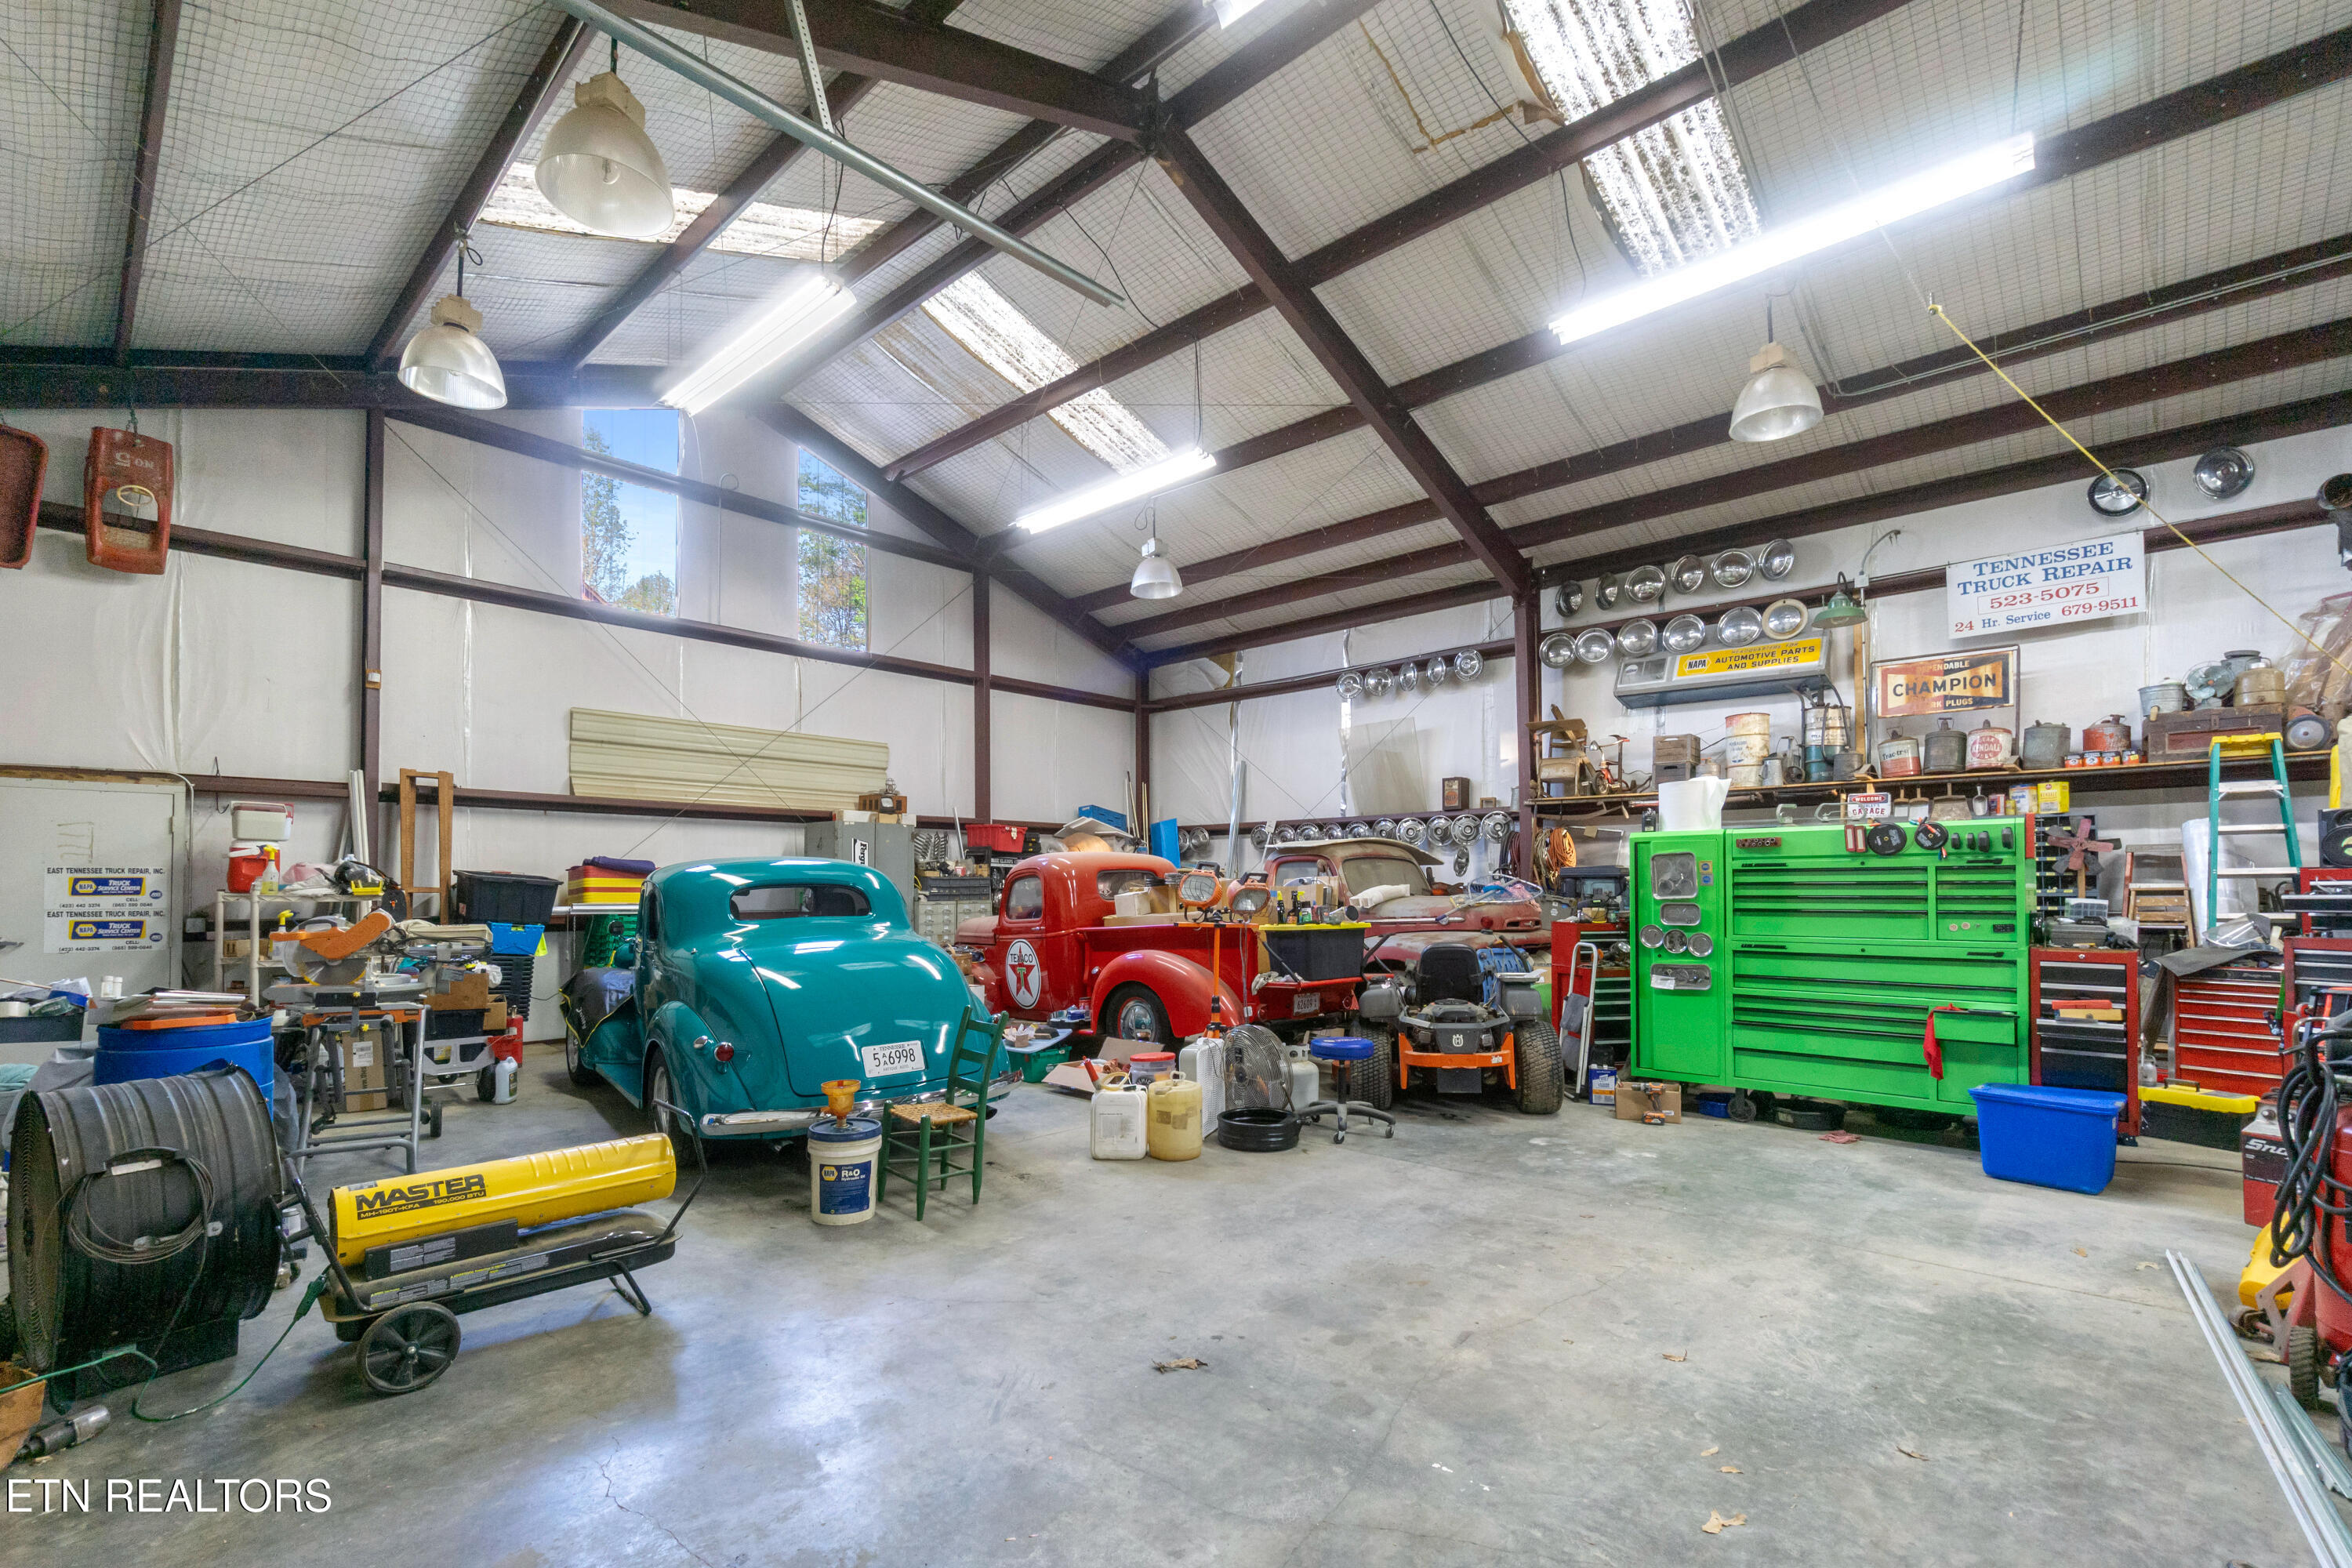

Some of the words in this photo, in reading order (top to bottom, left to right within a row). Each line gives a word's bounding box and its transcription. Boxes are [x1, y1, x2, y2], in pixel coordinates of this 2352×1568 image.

[1973, 542, 2114, 577] TENNESSEE
[1957, 573, 2032, 595] TRUCK
[2042, 557, 2133, 583] REPAIR
[1990, 582, 2100, 609] 523-5075
[1955, 620, 1974, 633] 24
[1981, 618, 2001, 629] Hr.
[2005, 611, 2051, 625] Service
[2061, 596, 2138, 616] 679-9511
[1715, 651, 1777, 664] AUTOMOTIVE
[1780, 645, 1815, 655] PARTS
[1726, 662, 1747, 670] AND
[1751, 656, 1799, 667] SUPPLIES
[1687, 659, 1707, 670] NAPA
[1893, 673, 1996, 697] CHAMPION
[1946, 698, 1973, 706] PLUGS
[1972, 743, 2002, 752] KENDALL
[1010, 953, 1033, 963] TEXACO
[1017, 967, 1026, 988] T
[2245, 1138, 2289, 1156] Sna
[841, 1169, 860, 1178] R&O
[355, 1174, 487, 1210] MASTER
[434, 1195, 466, 1204] 190,000
